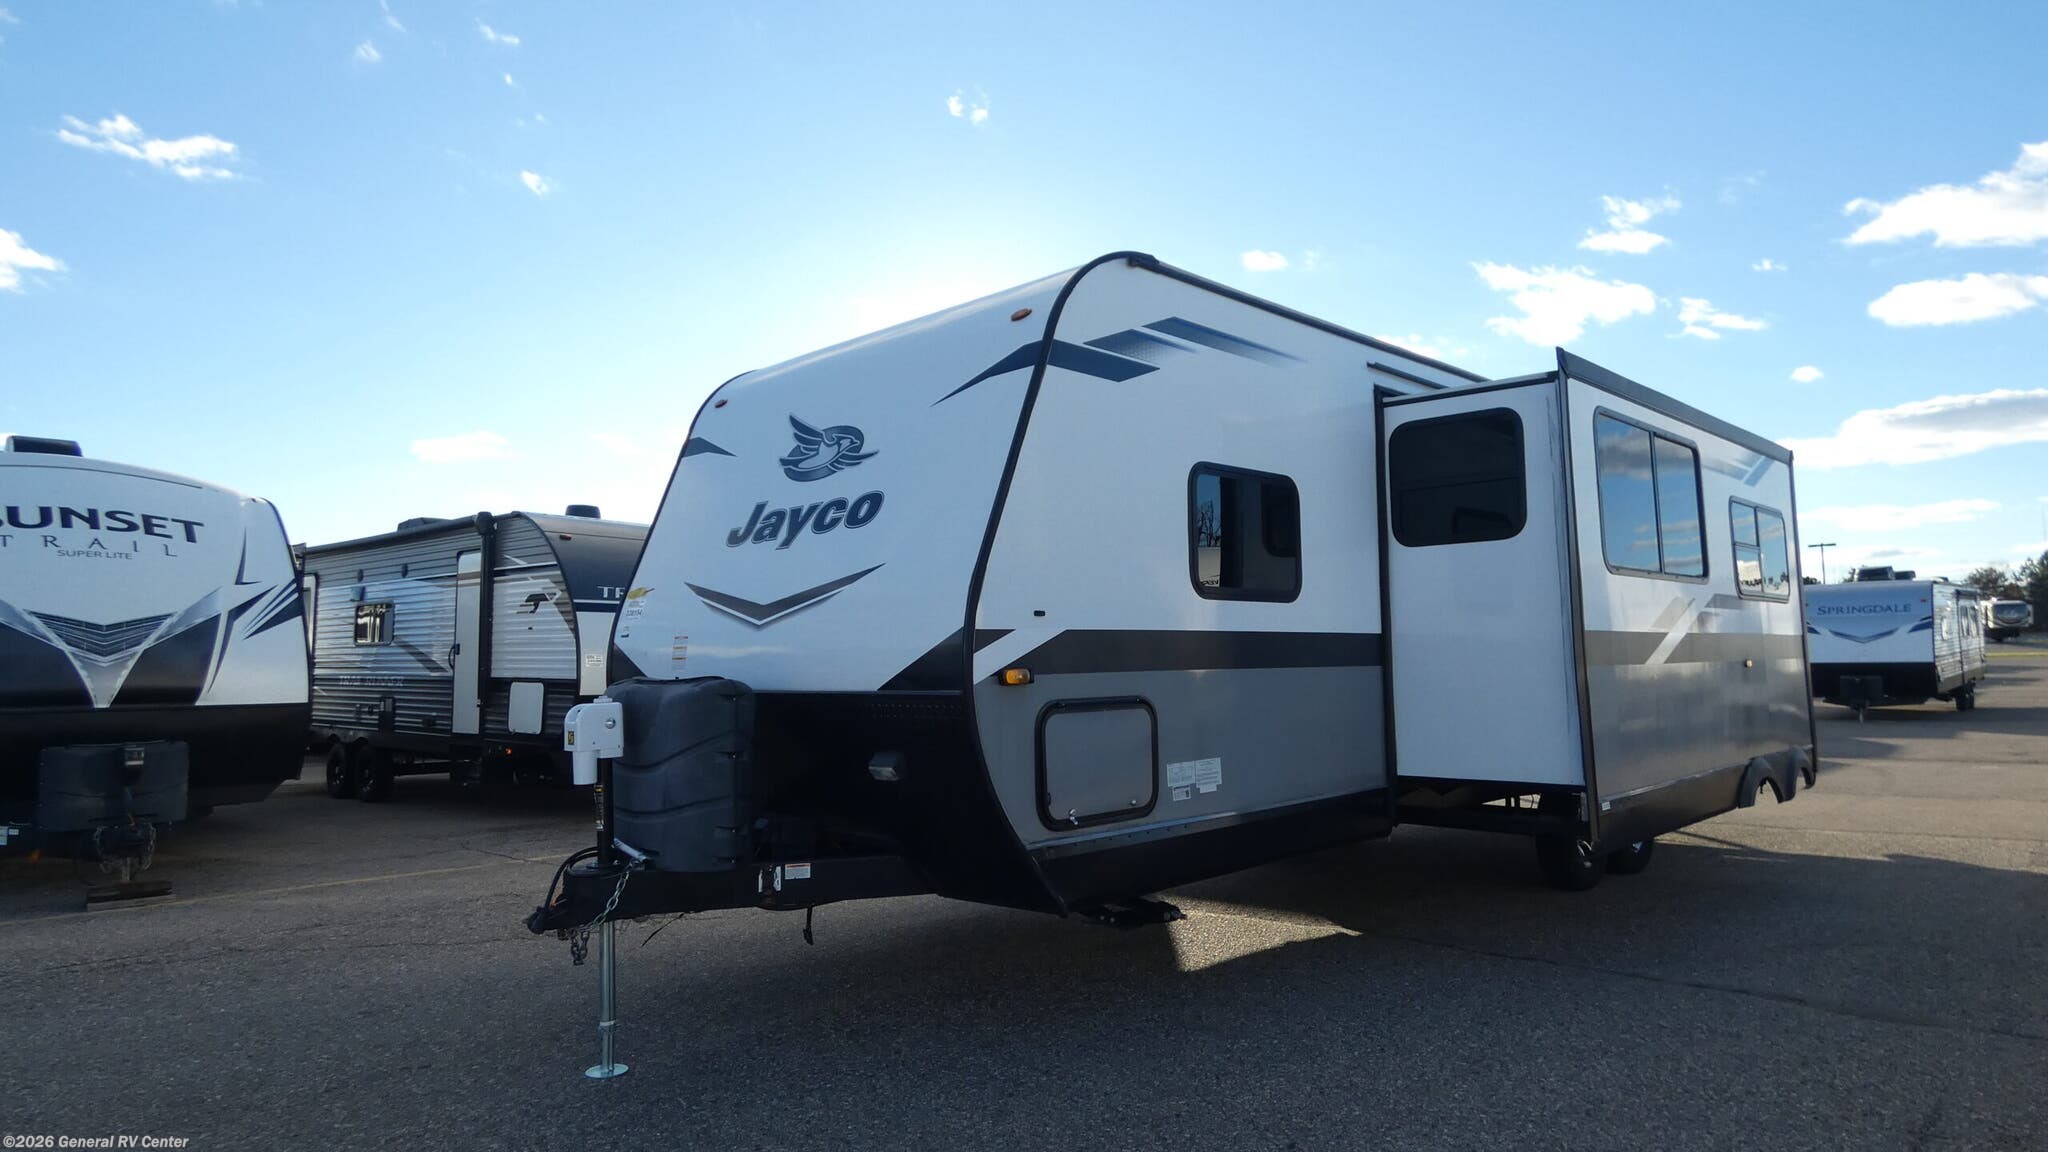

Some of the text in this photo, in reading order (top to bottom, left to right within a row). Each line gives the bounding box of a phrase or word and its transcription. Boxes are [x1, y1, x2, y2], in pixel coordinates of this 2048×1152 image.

[0, 505, 204, 543] UNSET
[726, 490, 885, 550] Jayco
[57, 549, 134, 560] SUPER LITE
[1817, 604, 1912, 615] SPRINGDALE
